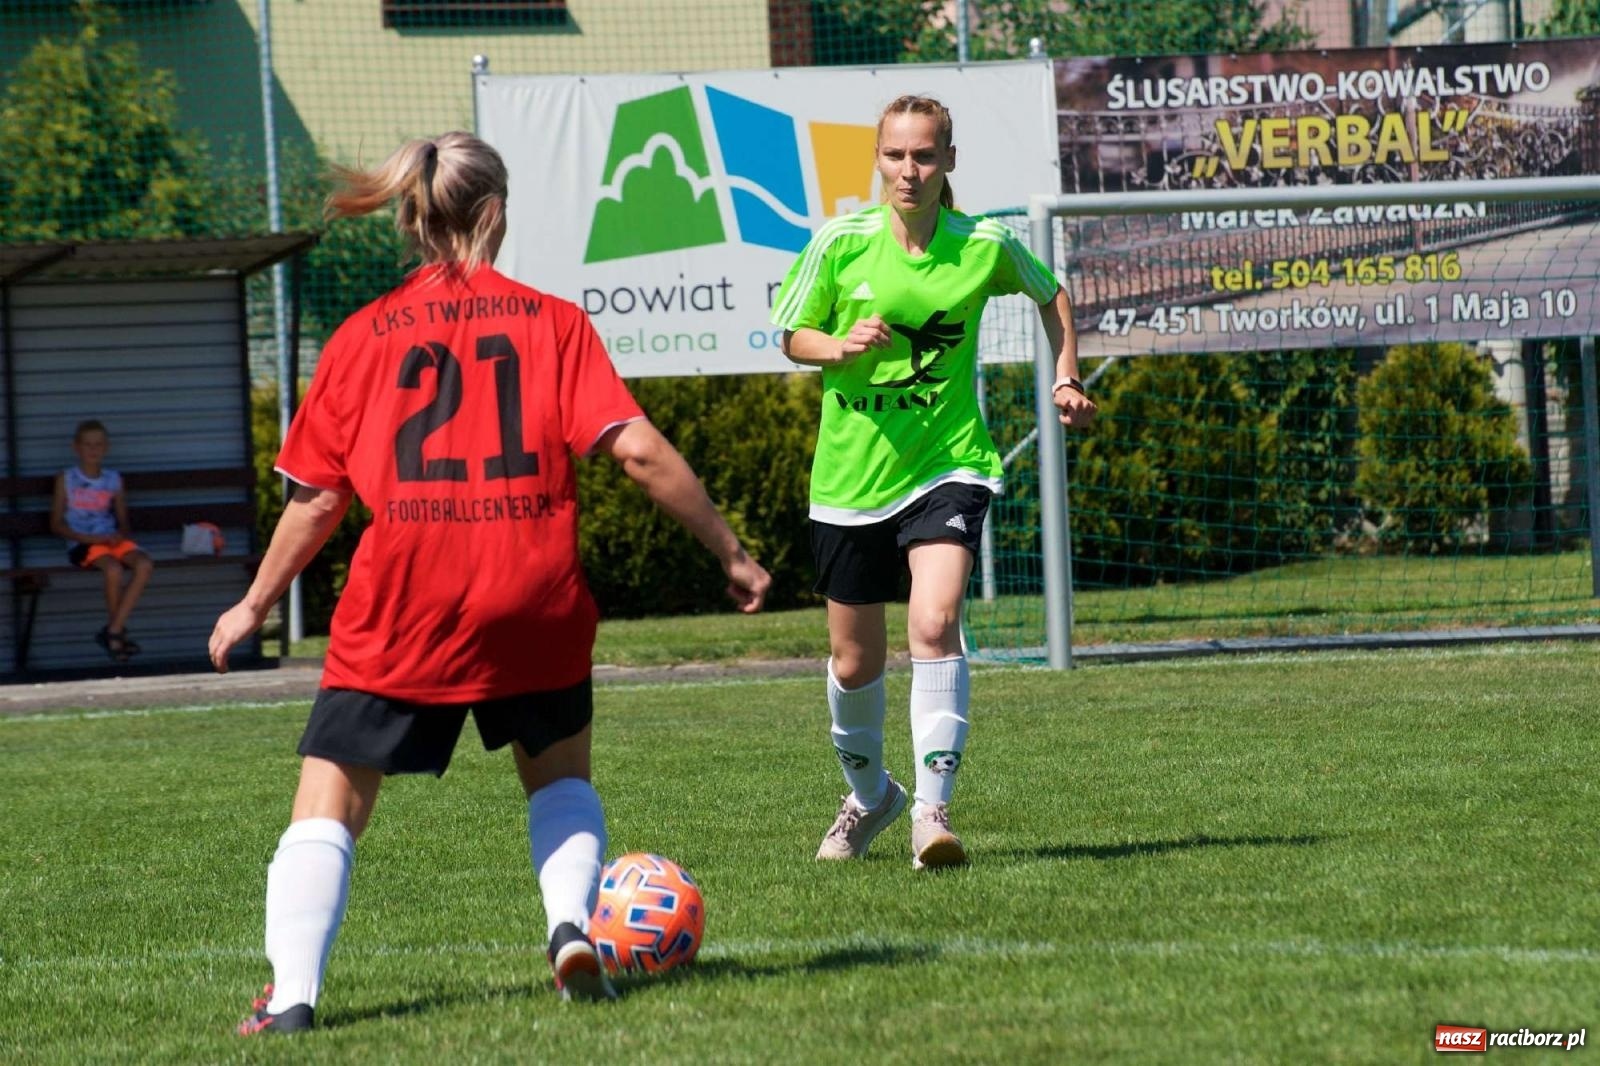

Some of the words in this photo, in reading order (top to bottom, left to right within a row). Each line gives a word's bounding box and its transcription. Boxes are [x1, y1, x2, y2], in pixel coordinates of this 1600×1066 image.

[1106, 61, 1551, 110] ŚLUSARSTWO-KOWALSTWO
[582, 272, 736, 316] powiat
[1210, 260, 1264, 292] tel.
[1271, 258, 1331, 290] 504
[1342, 257, 1397, 286] 165
[1403, 251, 1462, 283] 816
[372, 305, 417, 337] LKS
[424, 291, 543, 324] TWORKÓW
[1098, 307, 1202, 338] 47-451
[1213, 297, 1367, 334] Tworków,
[1374, 294, 1416, 327] ul.
[1425, 295, 1439, 325] 1
[1452, 288, 1530, 329] Maja
[1540, 288, 1578, 319] 10
[604, 328, 718, 354] ielona
[394, 332, 540, 483] 21
[387, 493, 557, 524] FOOTBALLCENTER.PL
